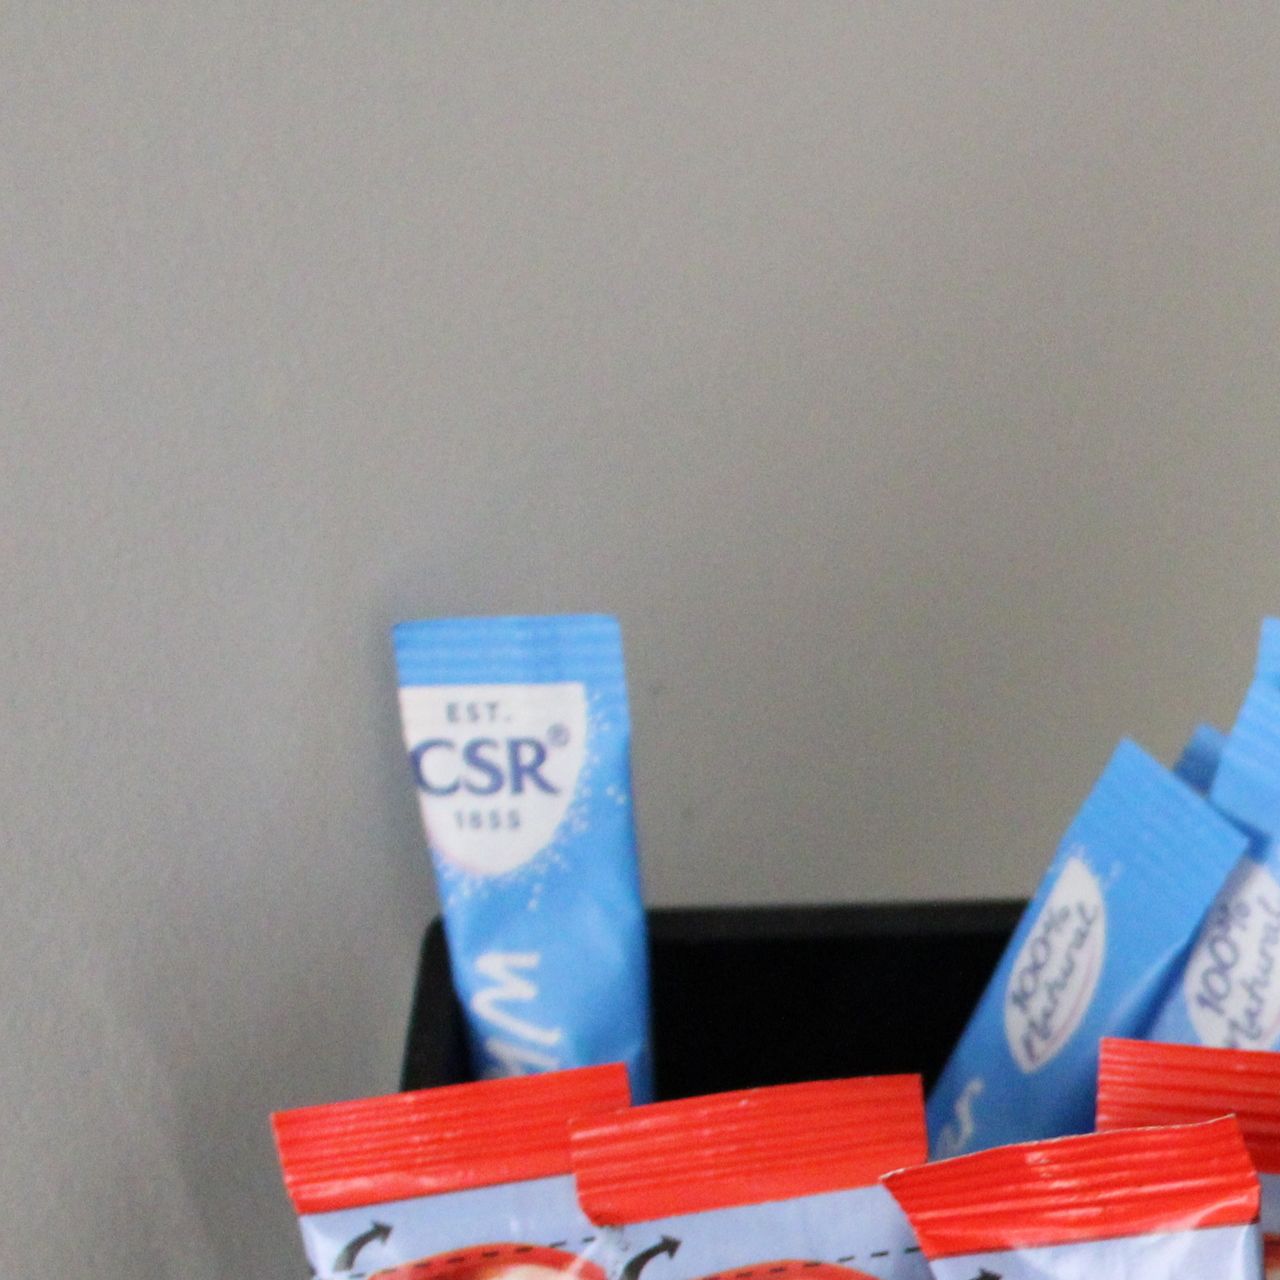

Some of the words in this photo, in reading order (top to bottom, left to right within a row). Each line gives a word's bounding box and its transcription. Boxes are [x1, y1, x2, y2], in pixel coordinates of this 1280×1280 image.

[410, 737, 558, 797] CSR
[1010, 902, 1070, 1011] 100%
[1196, 896, 1251, 1015] 100%
